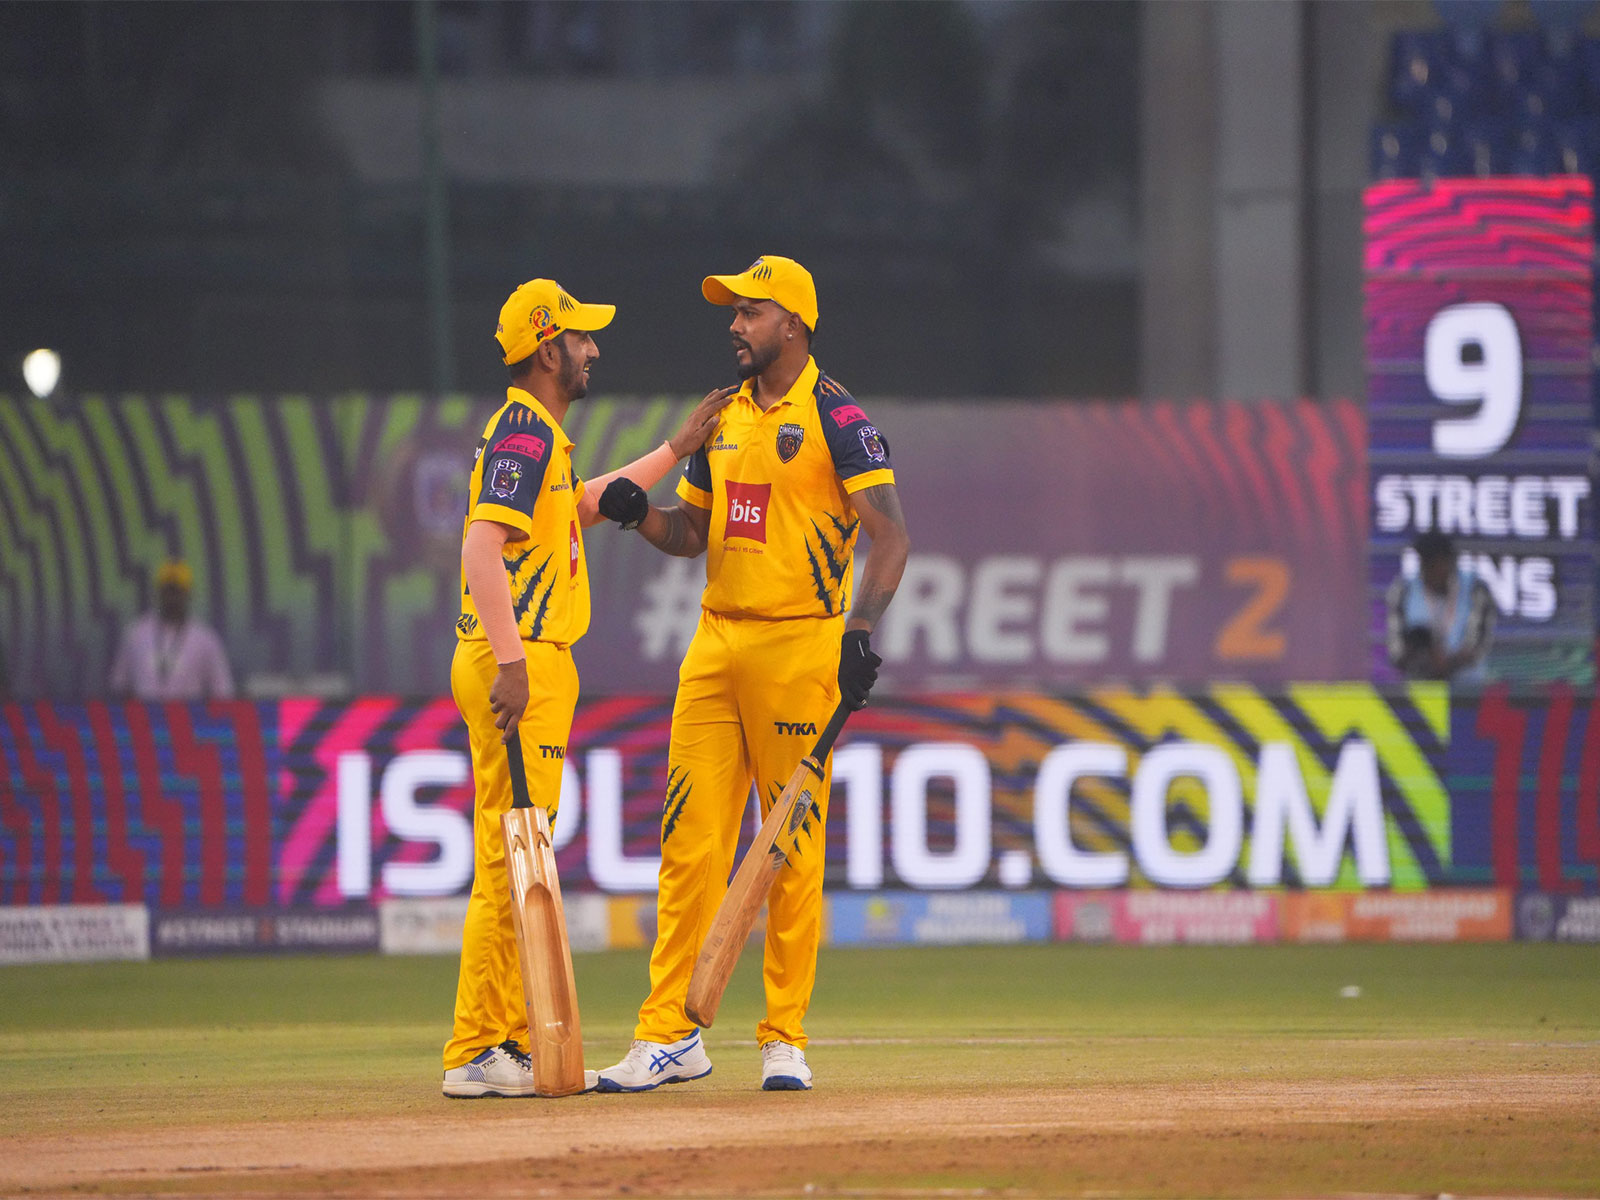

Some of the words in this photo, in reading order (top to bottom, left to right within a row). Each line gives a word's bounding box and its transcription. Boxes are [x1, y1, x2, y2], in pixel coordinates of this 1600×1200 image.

[1424, 302, 1523, 460] 9
[730, 498, 761, 523] ibis
[1375, 476, 1590, 539] STREET
[636, 556, 1197, 663] #REET
[1213, 558, 1291, 660] 2
[538, 744, 565, 759] TYK
[774, 721, 818, 735] TYKA
[336, 740, 1392, 897] ISL10.COM
